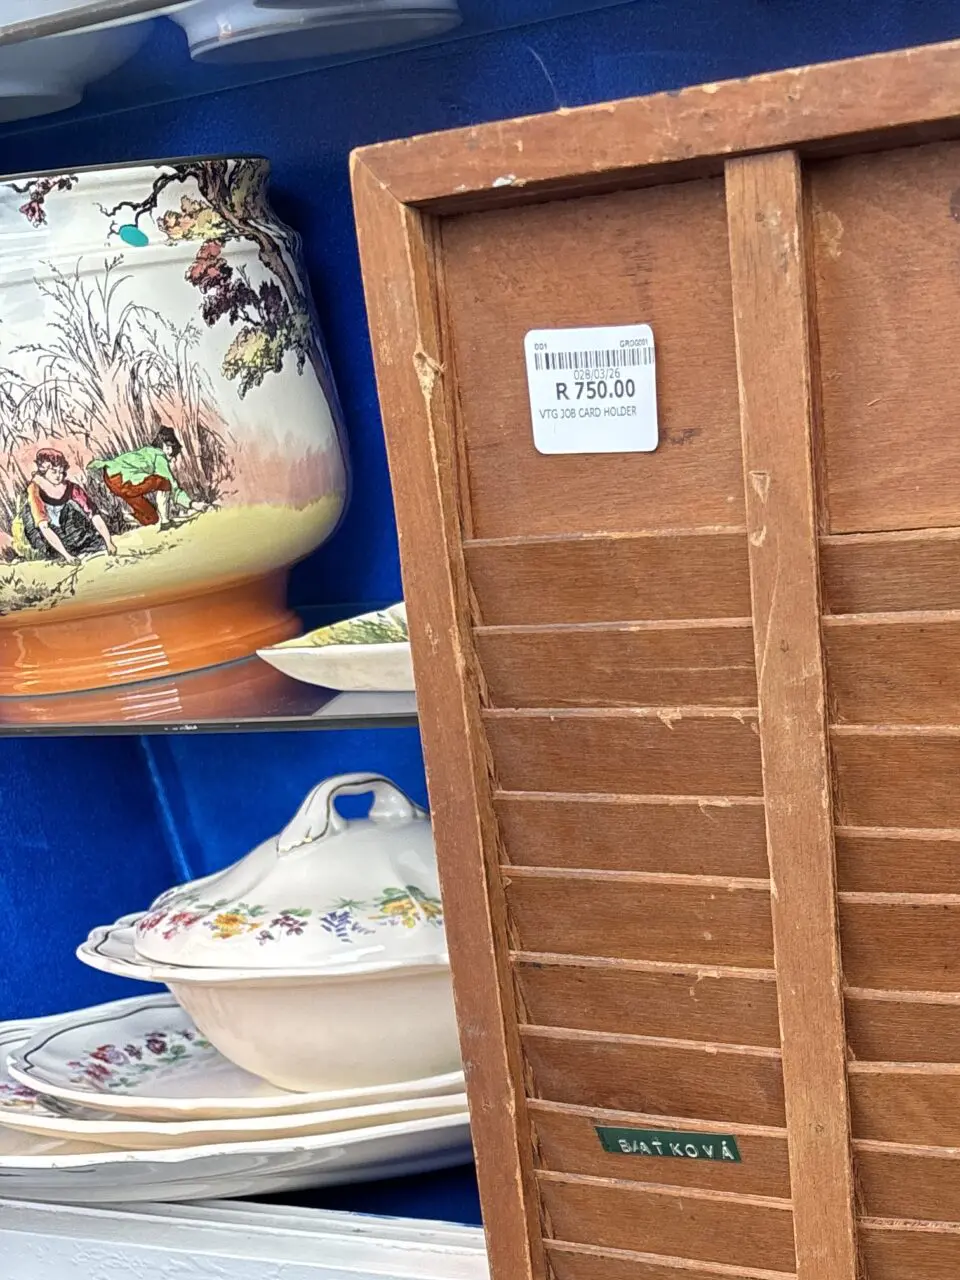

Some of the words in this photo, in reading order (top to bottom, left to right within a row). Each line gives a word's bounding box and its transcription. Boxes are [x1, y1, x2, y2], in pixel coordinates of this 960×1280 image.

[555, 382, 570, 401] R
[574, 379, 636, 400] 750.00
[539, 408, 559, 419] VTG
[560, 407, 576, 418] JOB
[578, 407, 601, 418] CARD
[603, 405, 637, 417] HOLDER
